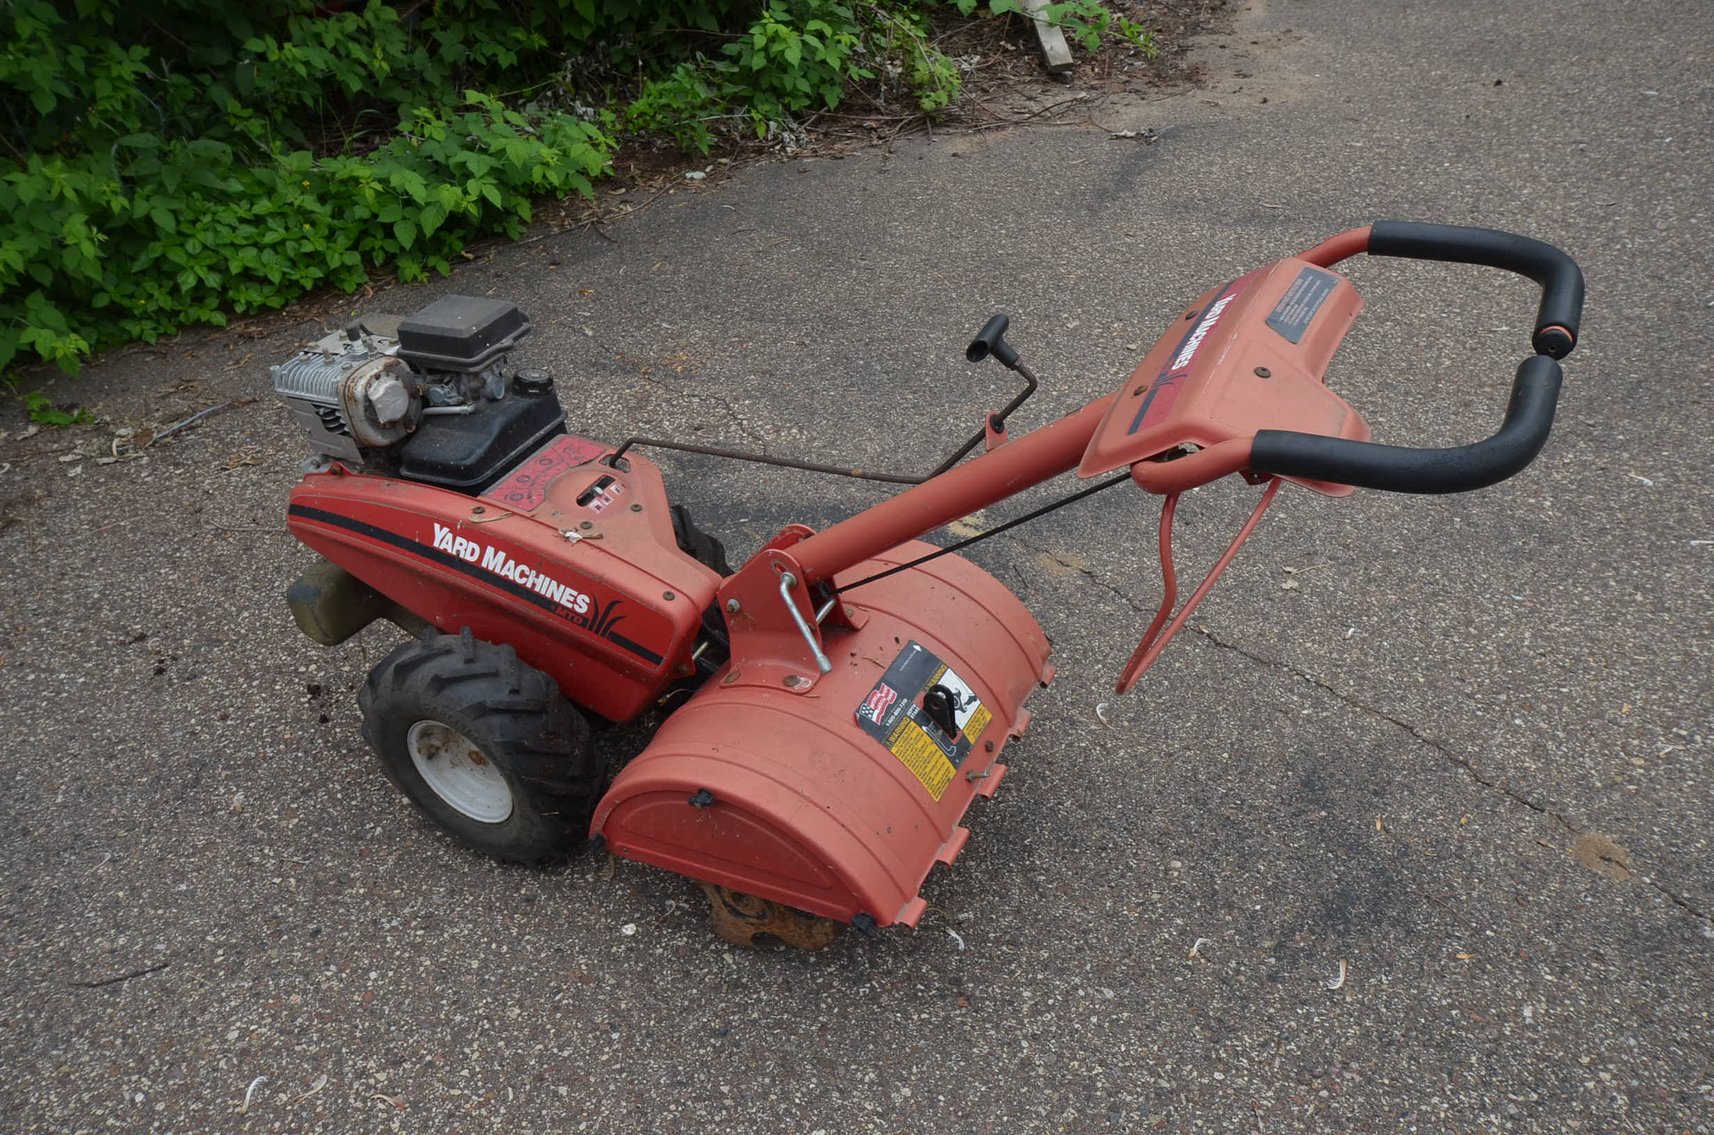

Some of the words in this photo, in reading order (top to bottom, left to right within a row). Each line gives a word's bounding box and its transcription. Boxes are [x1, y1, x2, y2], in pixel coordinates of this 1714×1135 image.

[1204, 293, 1237, 320] YARD
[1171, 315, 1221, 371] MACHINES
[432, 523, 481, 562] YARD
[480, 545, 591, 614] MACHINES
[556, 607, 585, 625] MTD
[889, 716, 910, 743] WARNING
